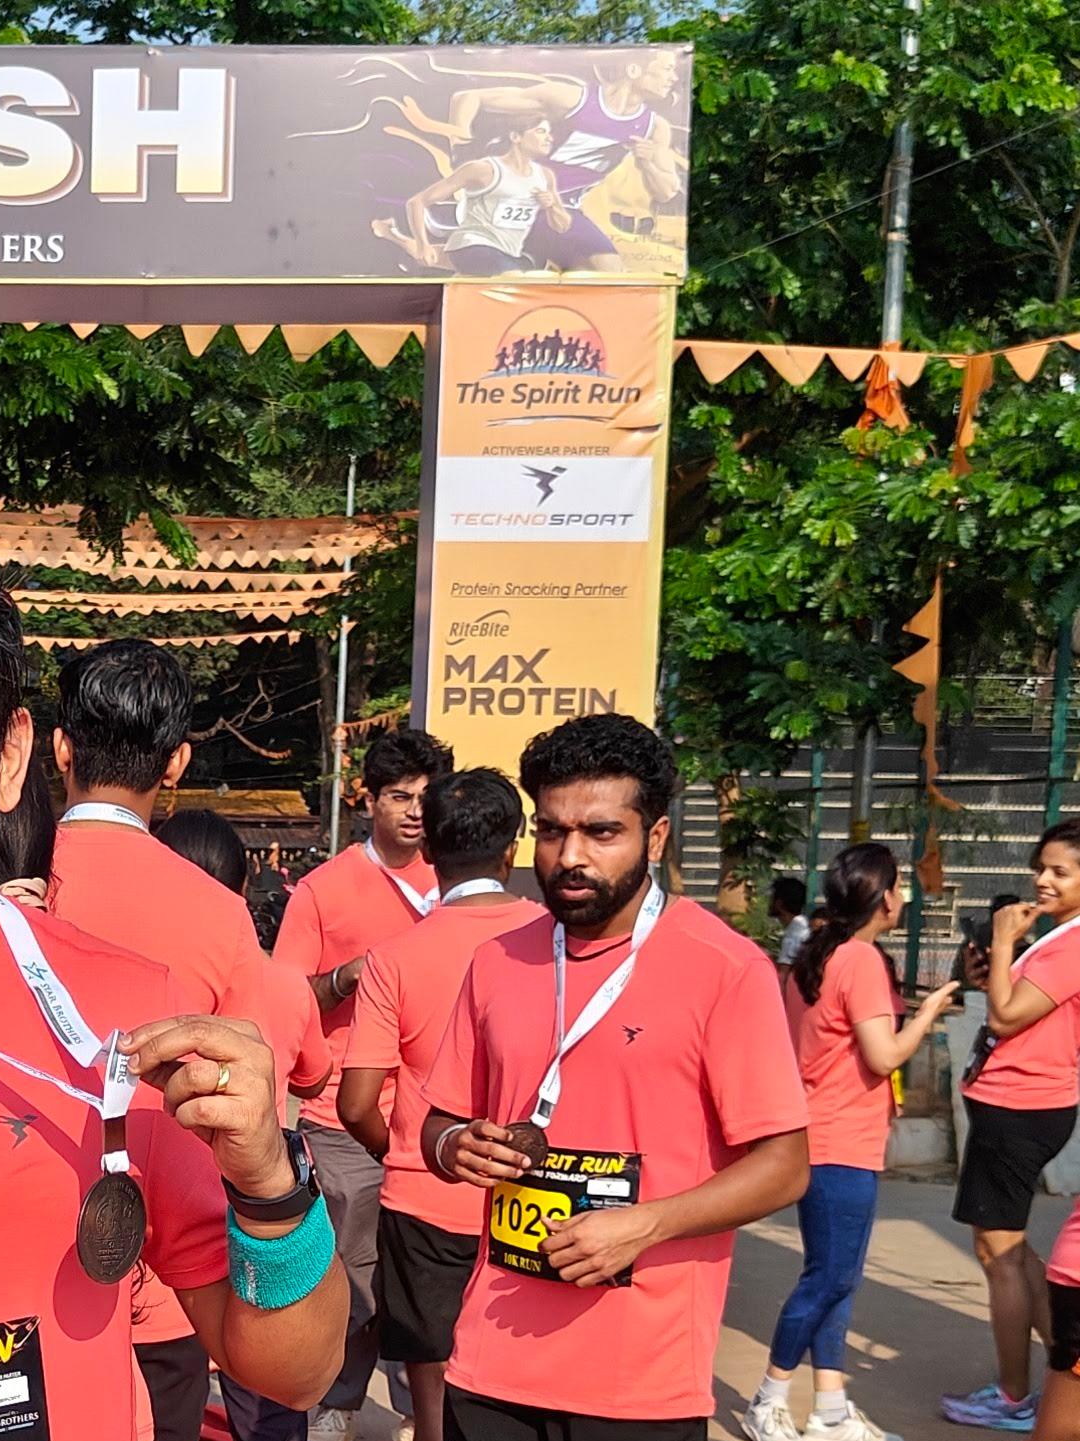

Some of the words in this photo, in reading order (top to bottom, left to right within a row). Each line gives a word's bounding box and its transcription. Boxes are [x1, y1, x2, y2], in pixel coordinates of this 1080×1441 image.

[500, 206, 533, 223] 325
[456, 381, 505, 404] The
[510, 380, 582, 410] Spirit
[588, 382, 641, 404] Run
[481, 445, 560, 456] ACTIVEWEAR
[562, 446, 610, 456] PARTER
[450, 512, 634, 527] TECHNOSPORT
[450, 582, 501, 597] Protein
[504, 582, 571, 599] Snacking
[573, 583, 628, 597] Partner
[448, 621, 510, 638] RiteBite
[444, 648, 552, 684] MAX
[442, 687, 617, 716] PROTEIN
[580, 1156, 626, 1174] RUN
[519, 1256, 542, 1273] RUN
